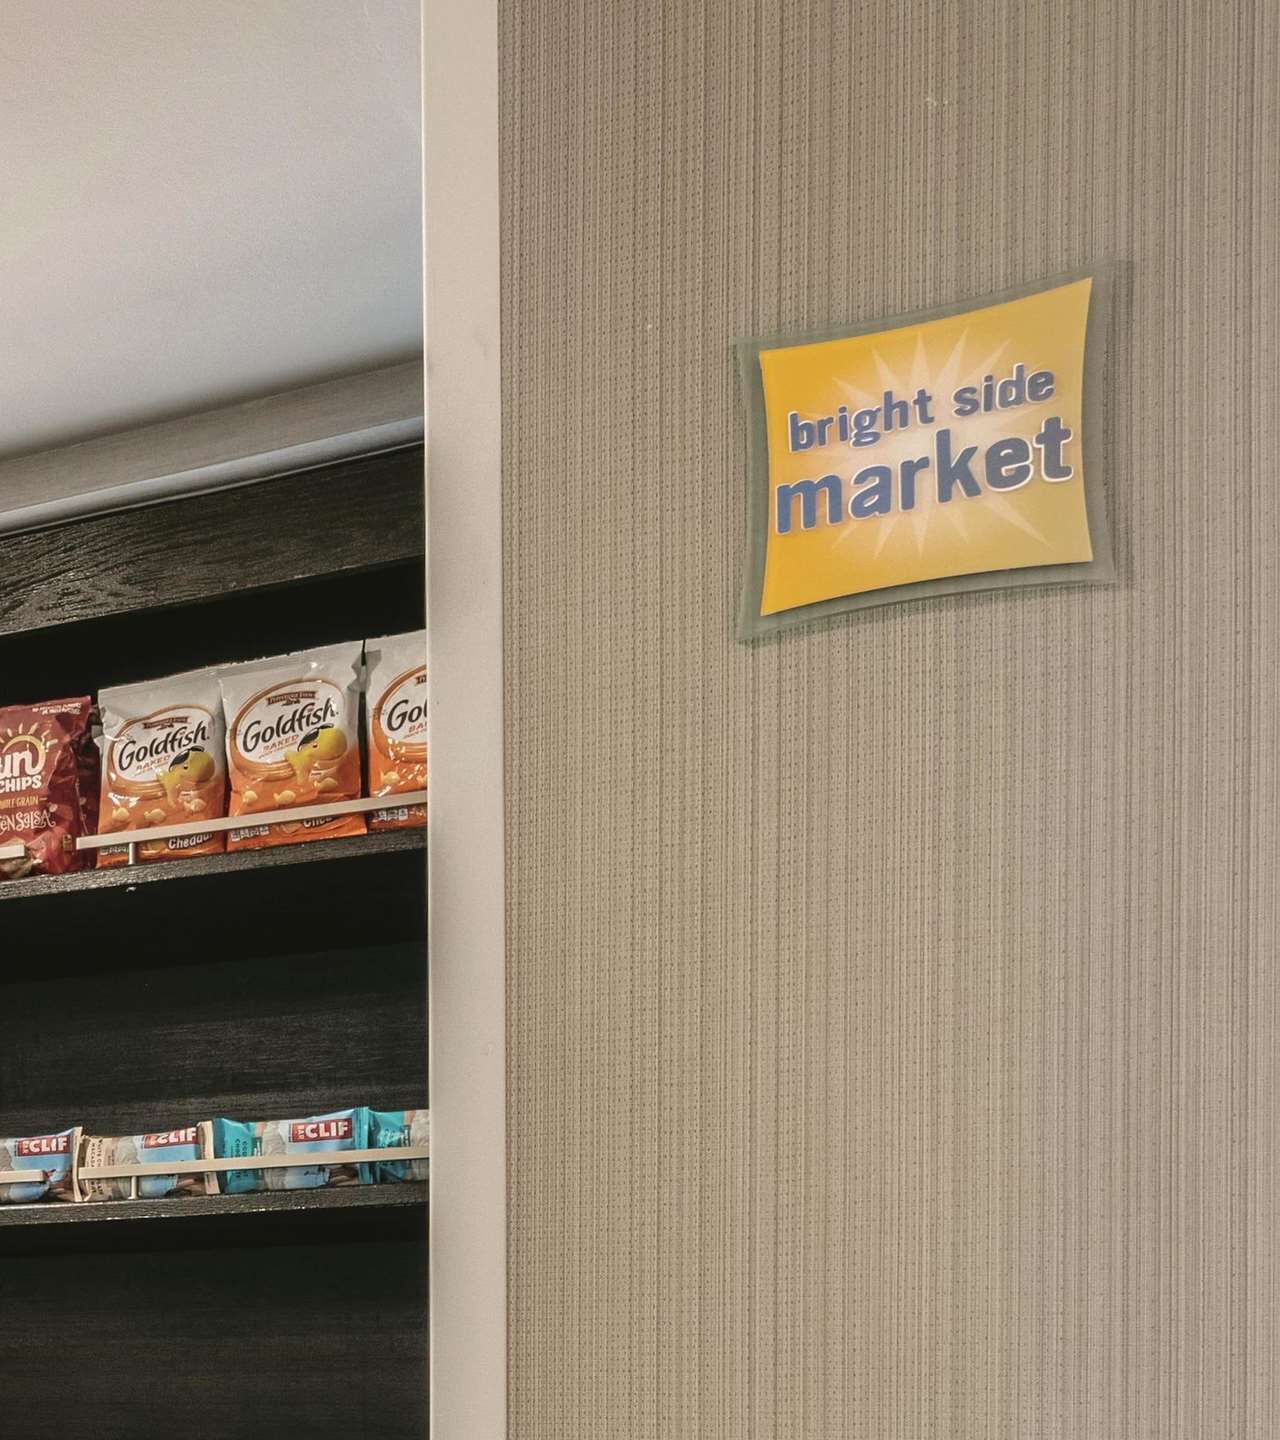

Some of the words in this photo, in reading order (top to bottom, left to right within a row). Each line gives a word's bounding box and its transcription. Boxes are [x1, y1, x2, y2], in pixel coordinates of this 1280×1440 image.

[787, 388, 935, 452] bright
[952, 363, 1056, 418] side
[775, 415, 1075, 534] market
[119, 721, 210, 771] Goldfish
[243, 698, 338, 752] Goldfish
[28, 1133, 69, 1154] CLIF
[159, 1129, 197, 1145] CLIF
[309, 1122, 349, 1138] CLIF
